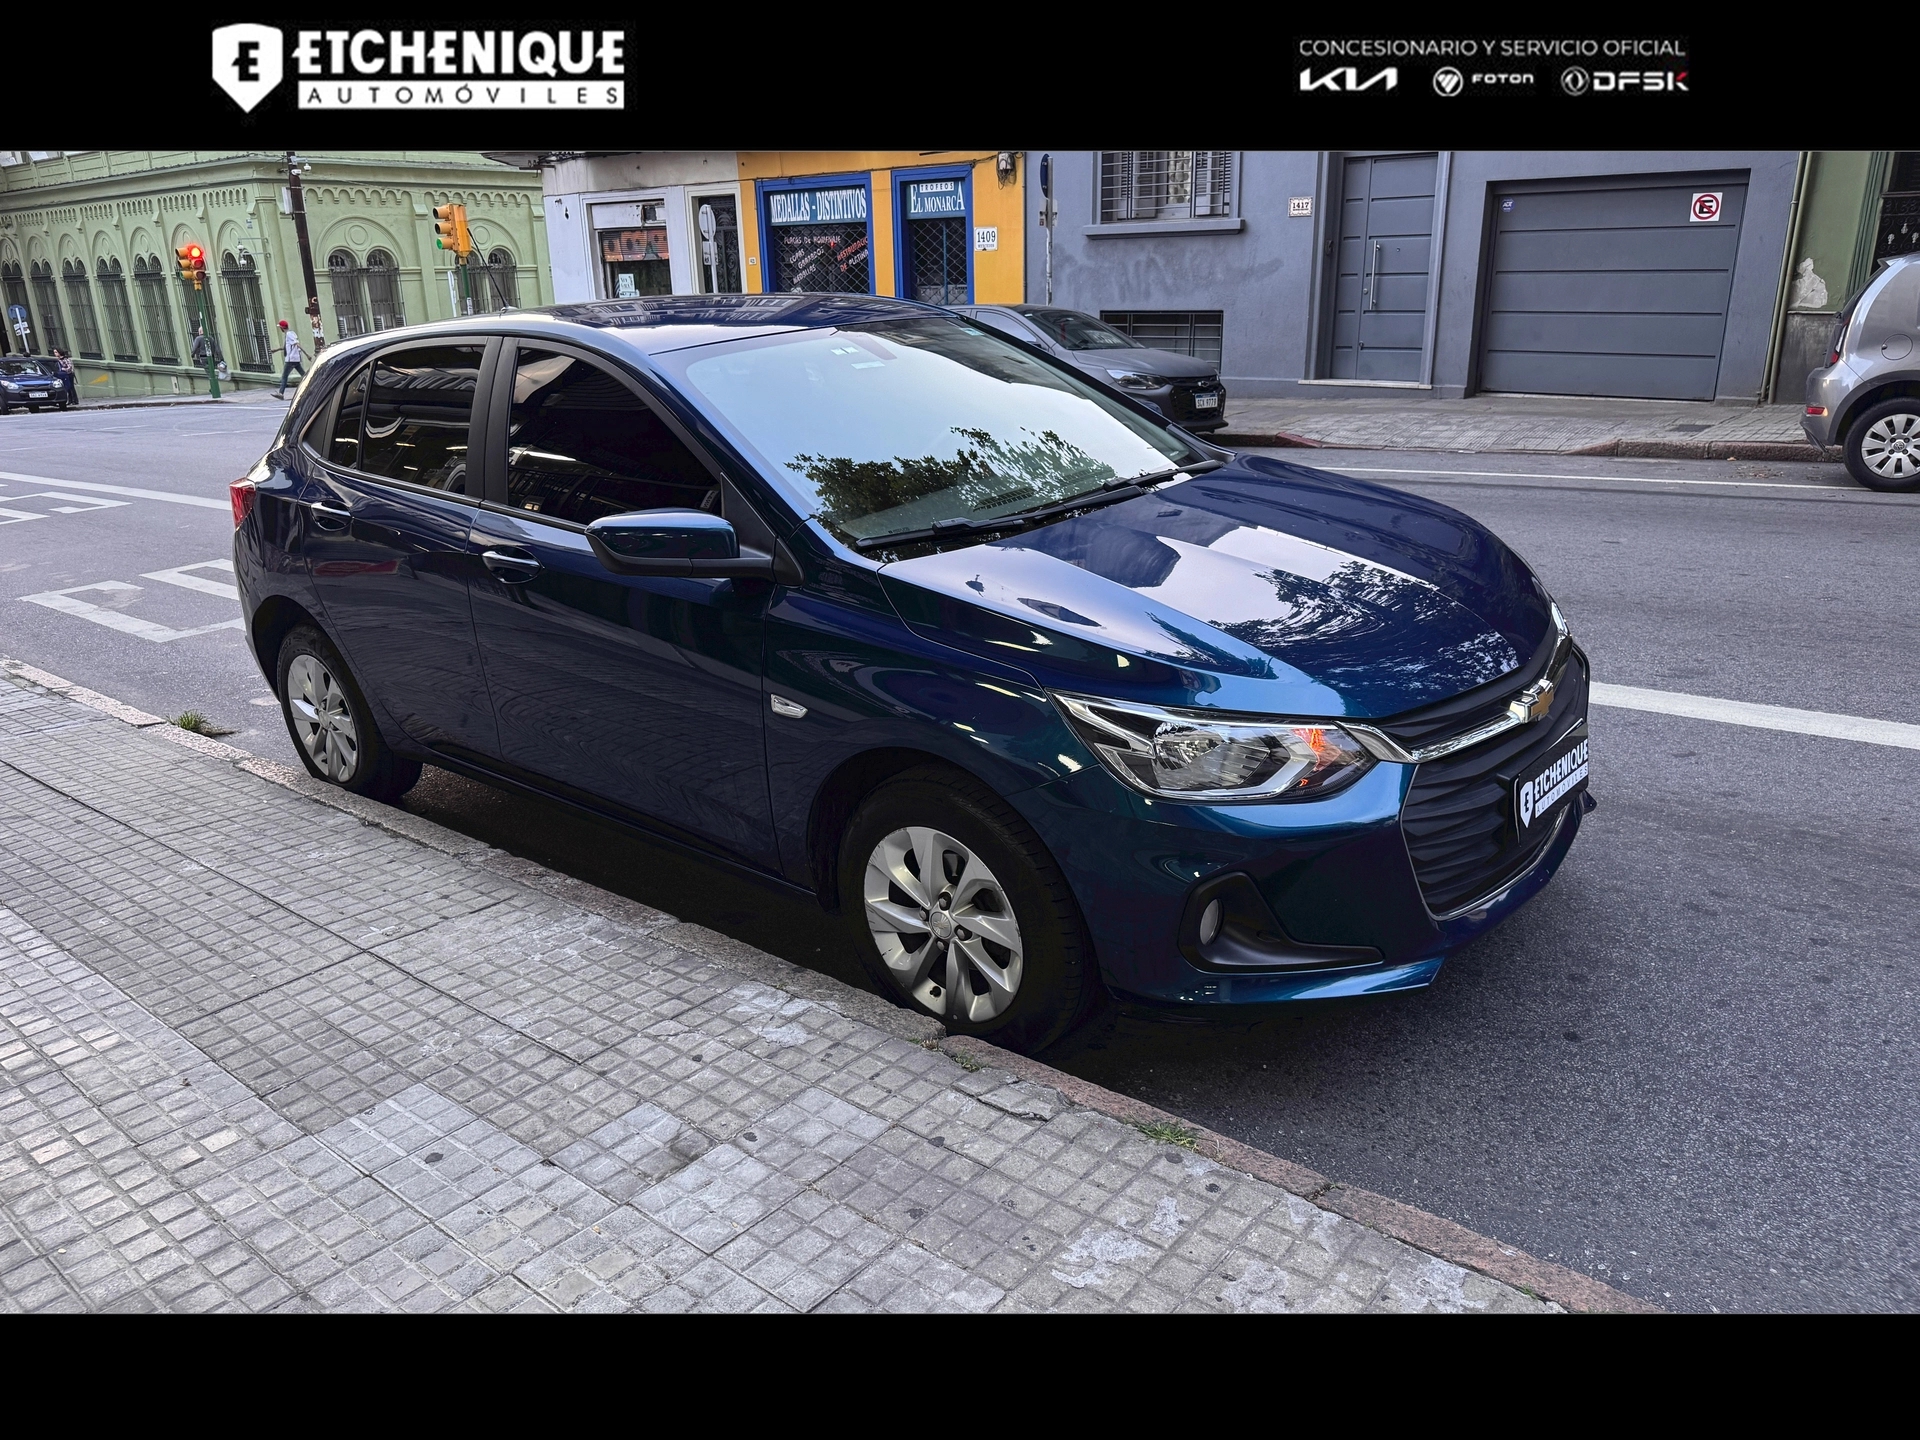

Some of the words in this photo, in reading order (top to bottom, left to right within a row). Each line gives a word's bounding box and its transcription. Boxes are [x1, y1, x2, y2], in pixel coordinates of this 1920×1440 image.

[921, 182, 954, 192] TROFEOS
[924, 181, 965, 212] MONARCA
[770, 192, 811, 223] MEDALLAS
[816, 188, 867, 220] DISTINTIVOS
[1293, 201, 1309, 209] 1417
[977, 231, 996, 243] 1409
[793, 264, 817, 285] MEDALLAS
[1534, 738, 1589, 801] ETCHENIQUE
